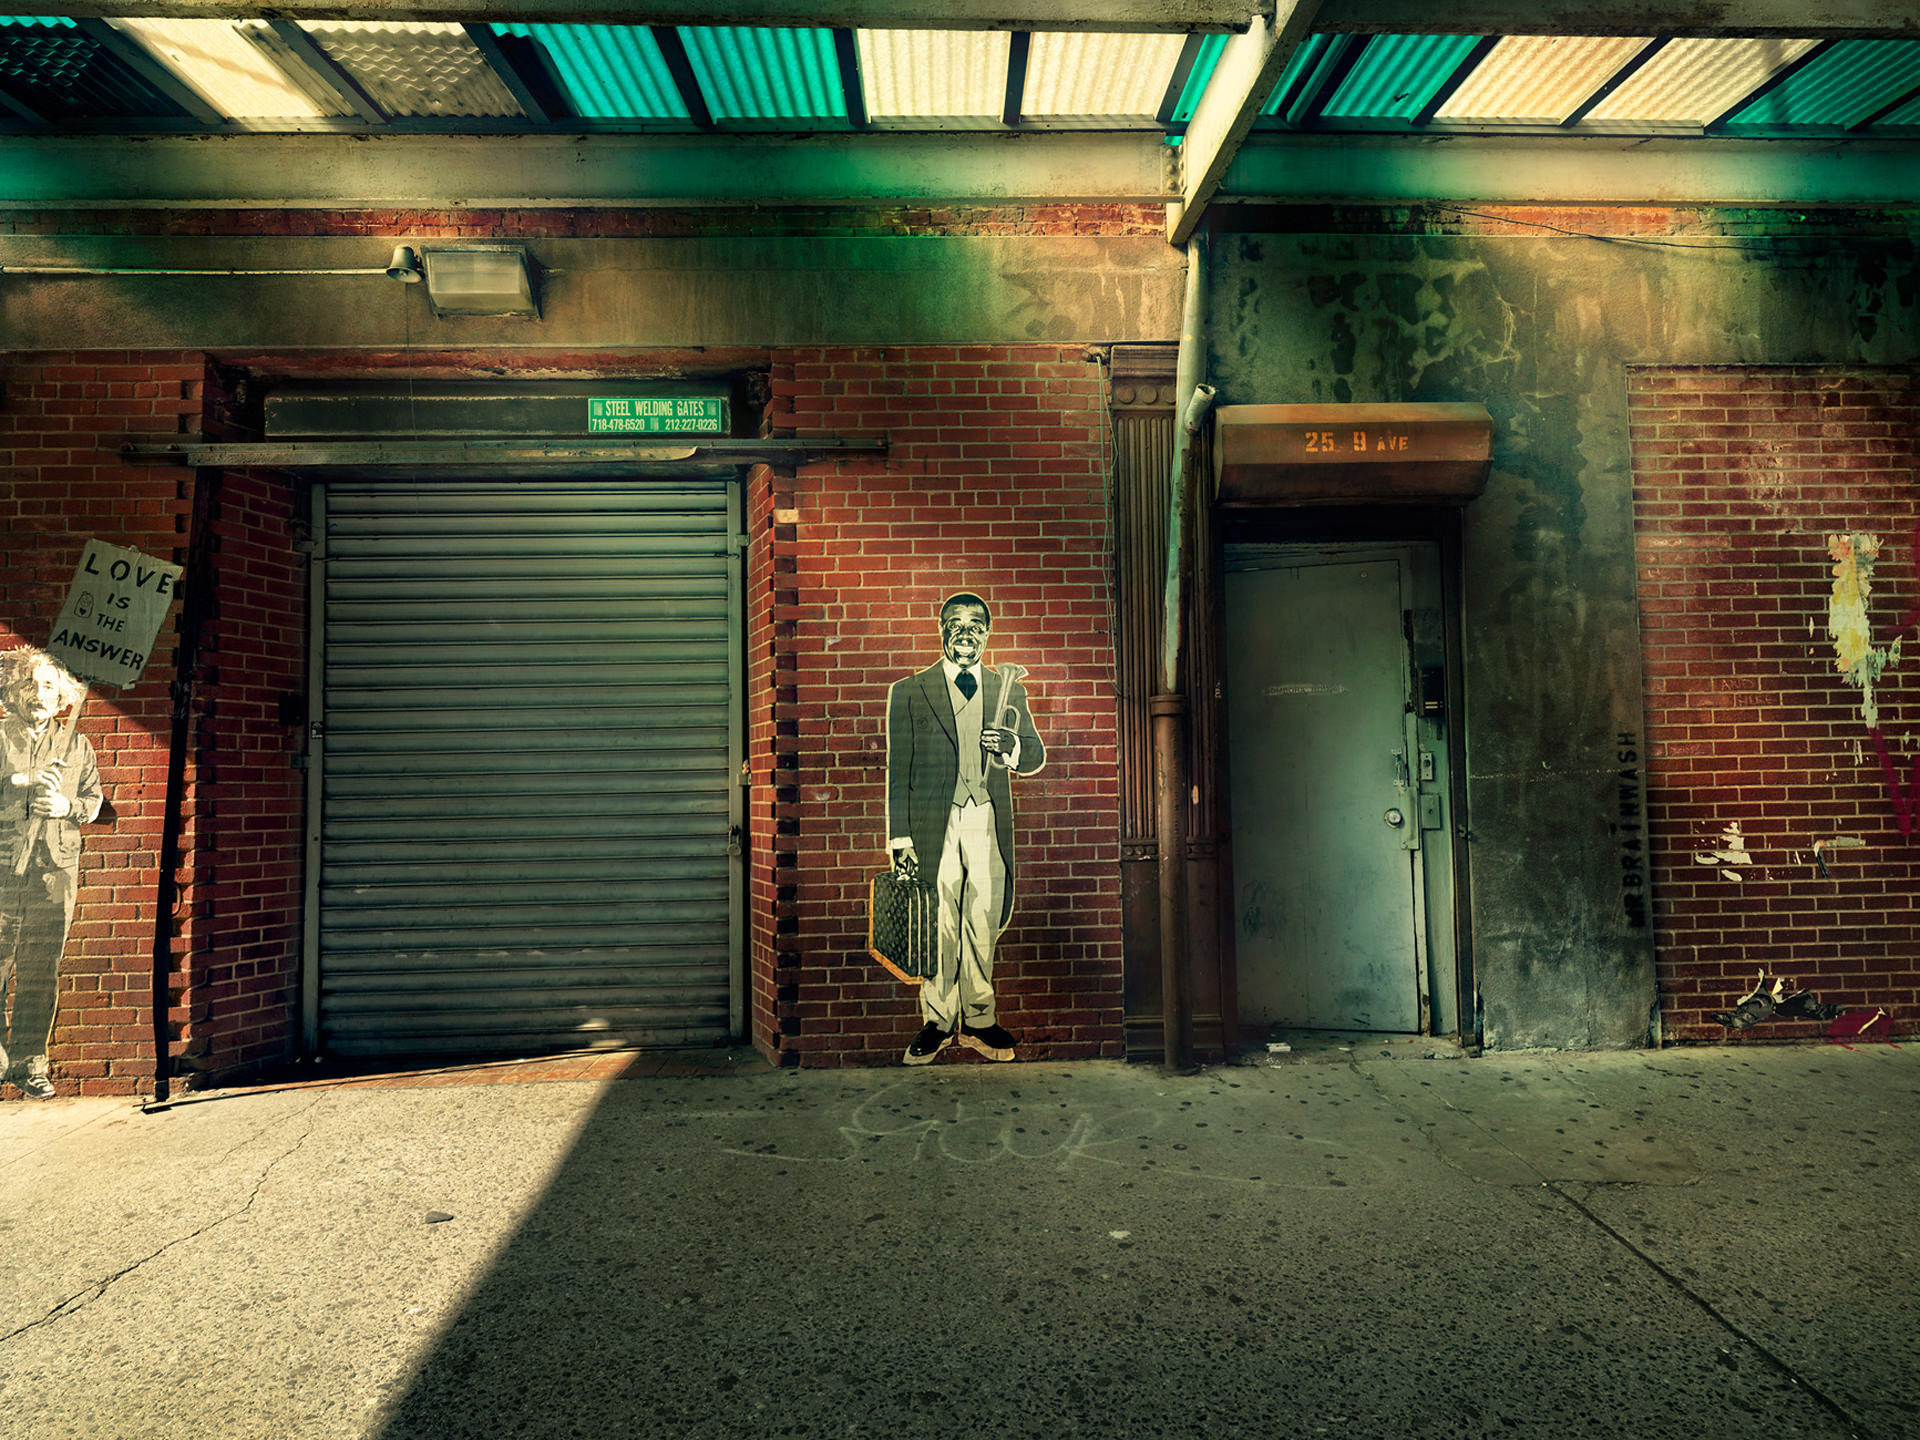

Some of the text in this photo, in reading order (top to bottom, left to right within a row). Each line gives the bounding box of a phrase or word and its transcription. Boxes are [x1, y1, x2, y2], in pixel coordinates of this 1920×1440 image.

[605, 401, 704, 416] STEEL WELDING GATES
[592, 418, 718, 431] 718-478-6520 212-227-0226
[1377, 436, 1409, 451] AVE
[84, 553, 173, 594] LOVE
[107, 593, 131, 609] IS
[97, 613, 125, 632] THE
[53, 629, 144, 670] ANSWER
